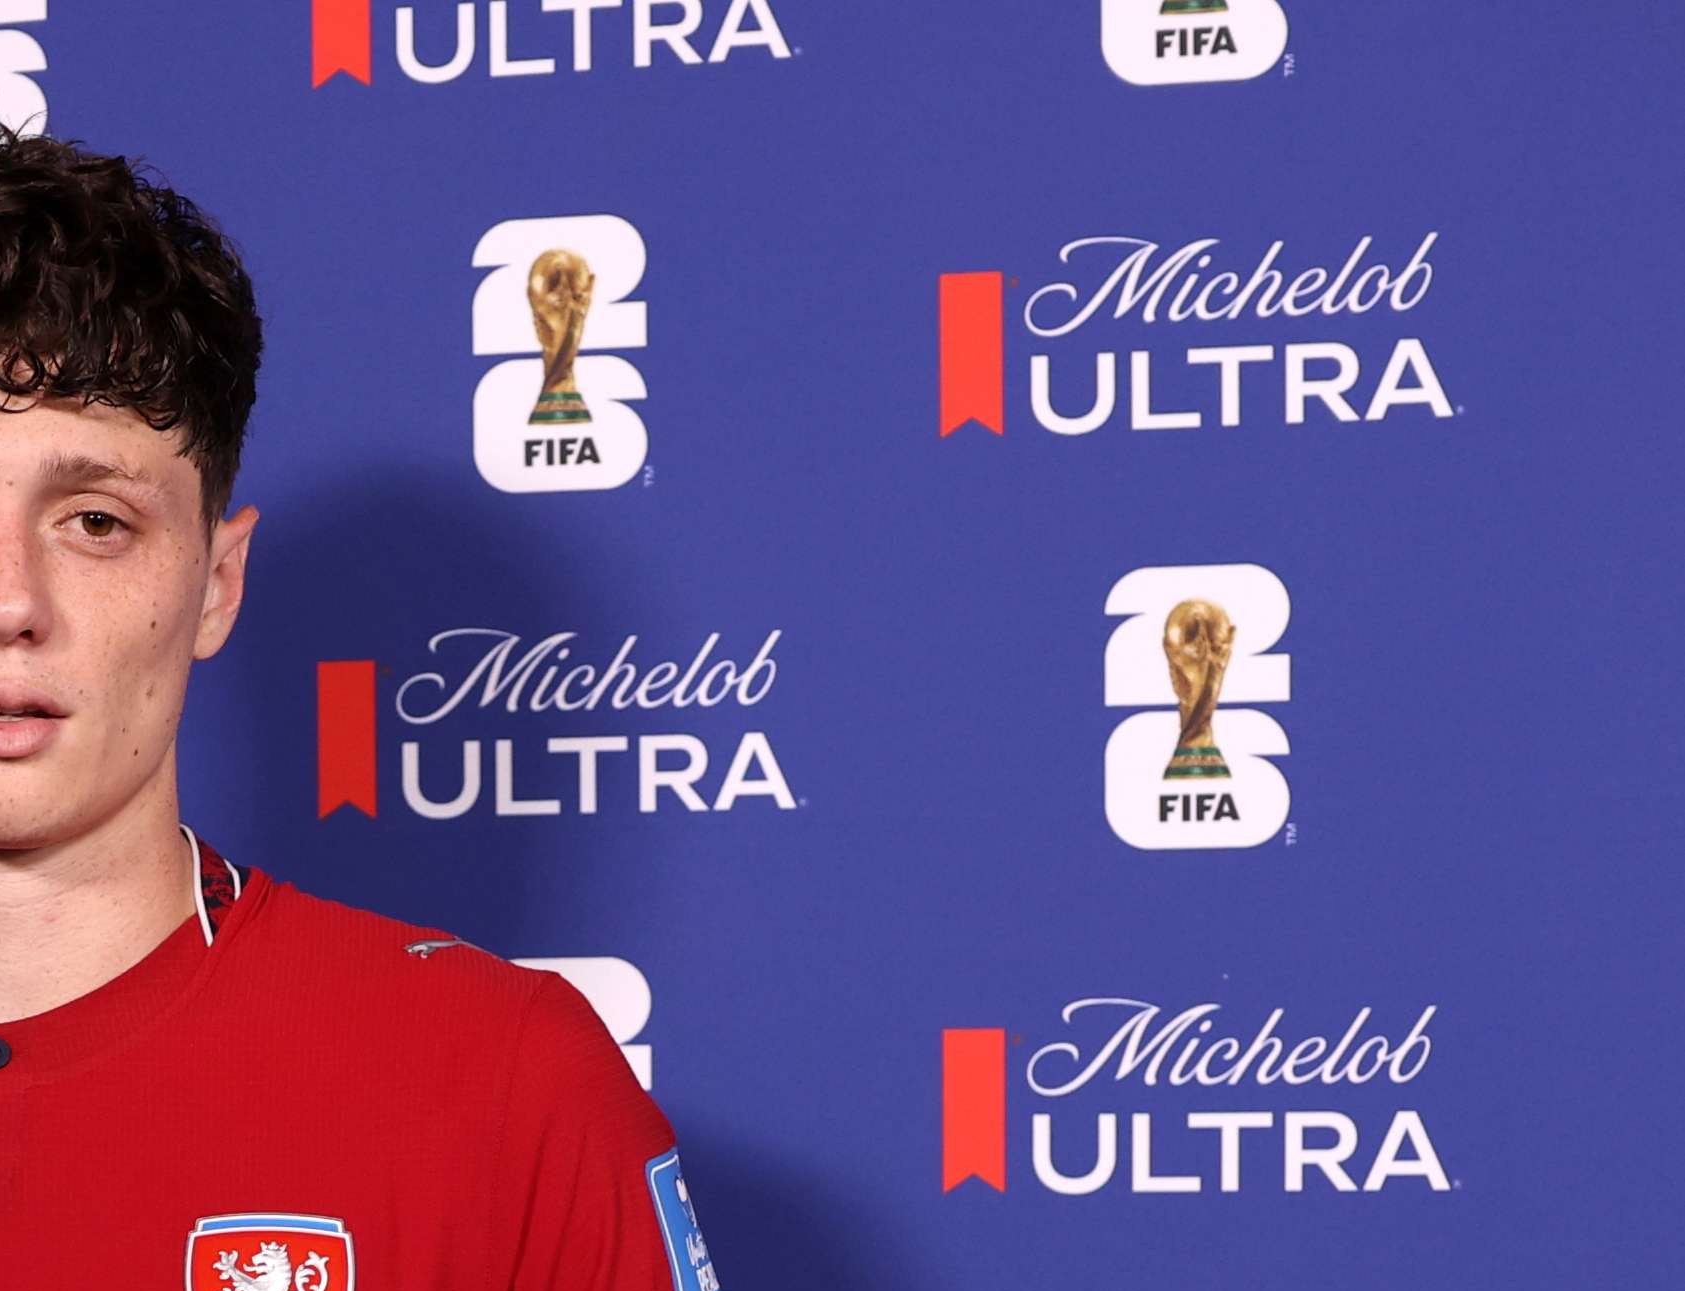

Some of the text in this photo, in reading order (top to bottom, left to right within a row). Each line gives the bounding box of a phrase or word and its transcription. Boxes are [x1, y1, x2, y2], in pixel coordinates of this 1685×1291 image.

[396, 0, 791, 84] ULTRA
[1155, 27, 1237, 58] FIFA
[1024, 232, 1438, 337] Michelob
[1031, 339, 1453, 435] ULTRA
[524, 437, 601, 467] FIFA
[396, 629, 781, 724] Michelob
[402, 732, 796, 819] ULTRA
[1159, 793, 1240, 823] FIFA
[1027, 998, 1436, 1096] Michelob
[1033, 1111, 1450, 1195] ULTRA
